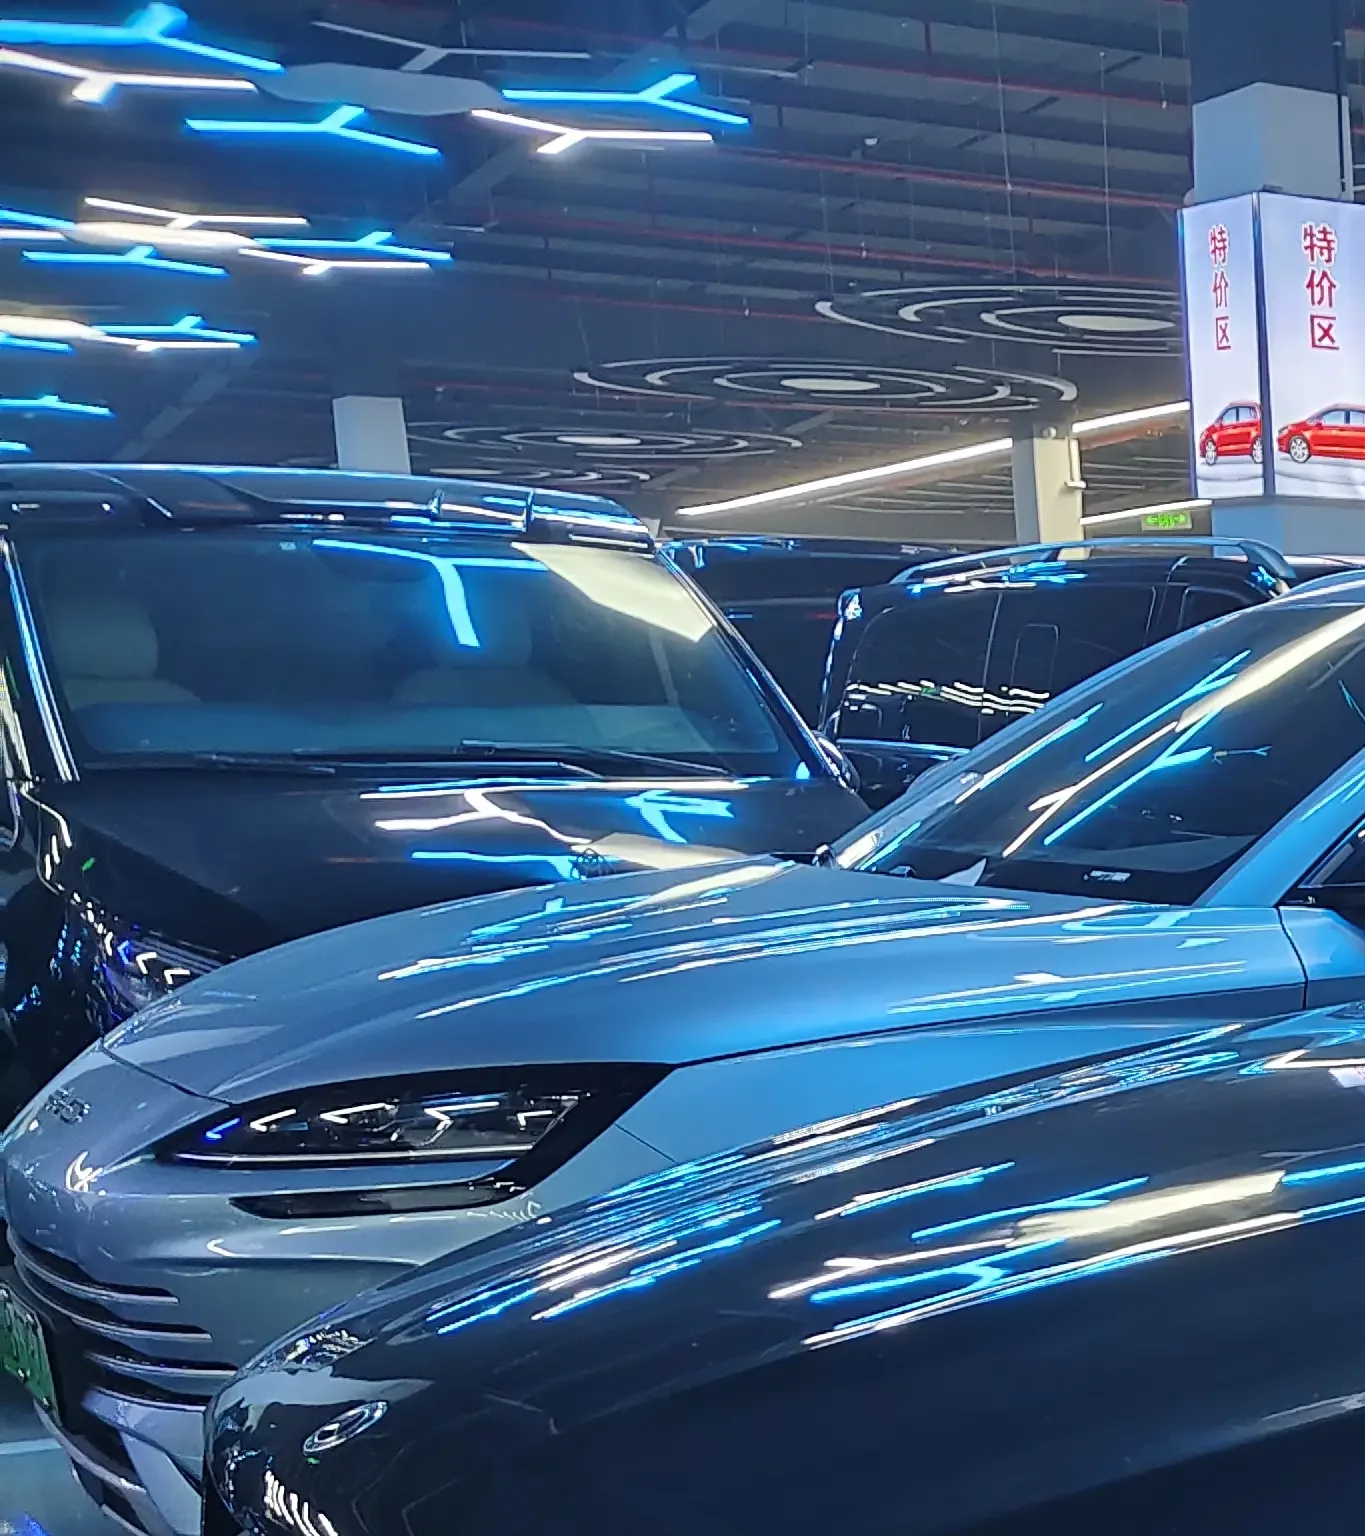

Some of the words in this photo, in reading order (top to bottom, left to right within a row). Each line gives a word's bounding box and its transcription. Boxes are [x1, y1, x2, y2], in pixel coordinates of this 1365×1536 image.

[1208, 225, 1232, 351] 特价区
[1302, 222, 1340, 351] 特价区
